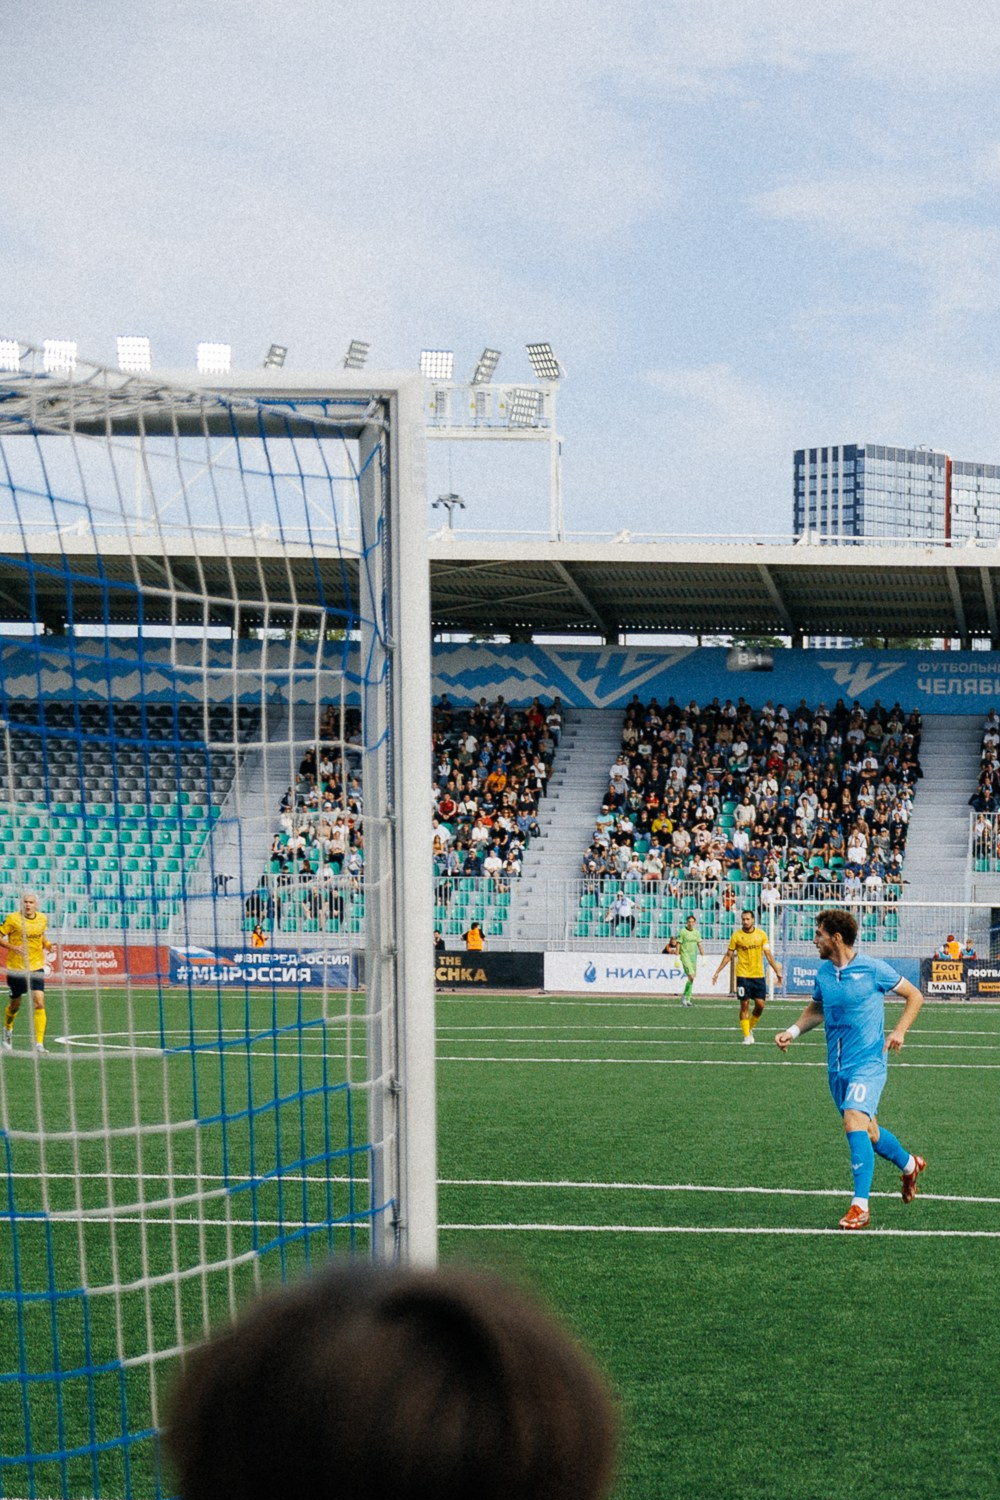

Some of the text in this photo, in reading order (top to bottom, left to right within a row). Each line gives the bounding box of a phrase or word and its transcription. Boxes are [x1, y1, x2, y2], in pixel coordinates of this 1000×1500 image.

[62, 950, 115, 959] РОССИЙСКИЙ
[233, 953, 349, 966] #ВПЕРЕДРОССИЯ
[62, 959, 118, 969] ФУТБОЛЬНЫЙ
[438, 956, 462, 966] THE
[935, 963, 960, 971] FOOT
[63, 969, 86, 977] СОЮЗ
[176, 966, 311, 982] #МЫРОССИЯ
[434, 967, 488, 982] CHKA
[936, 973, 957, 981] BALL
[846, 1082, 866, 1103] 70
